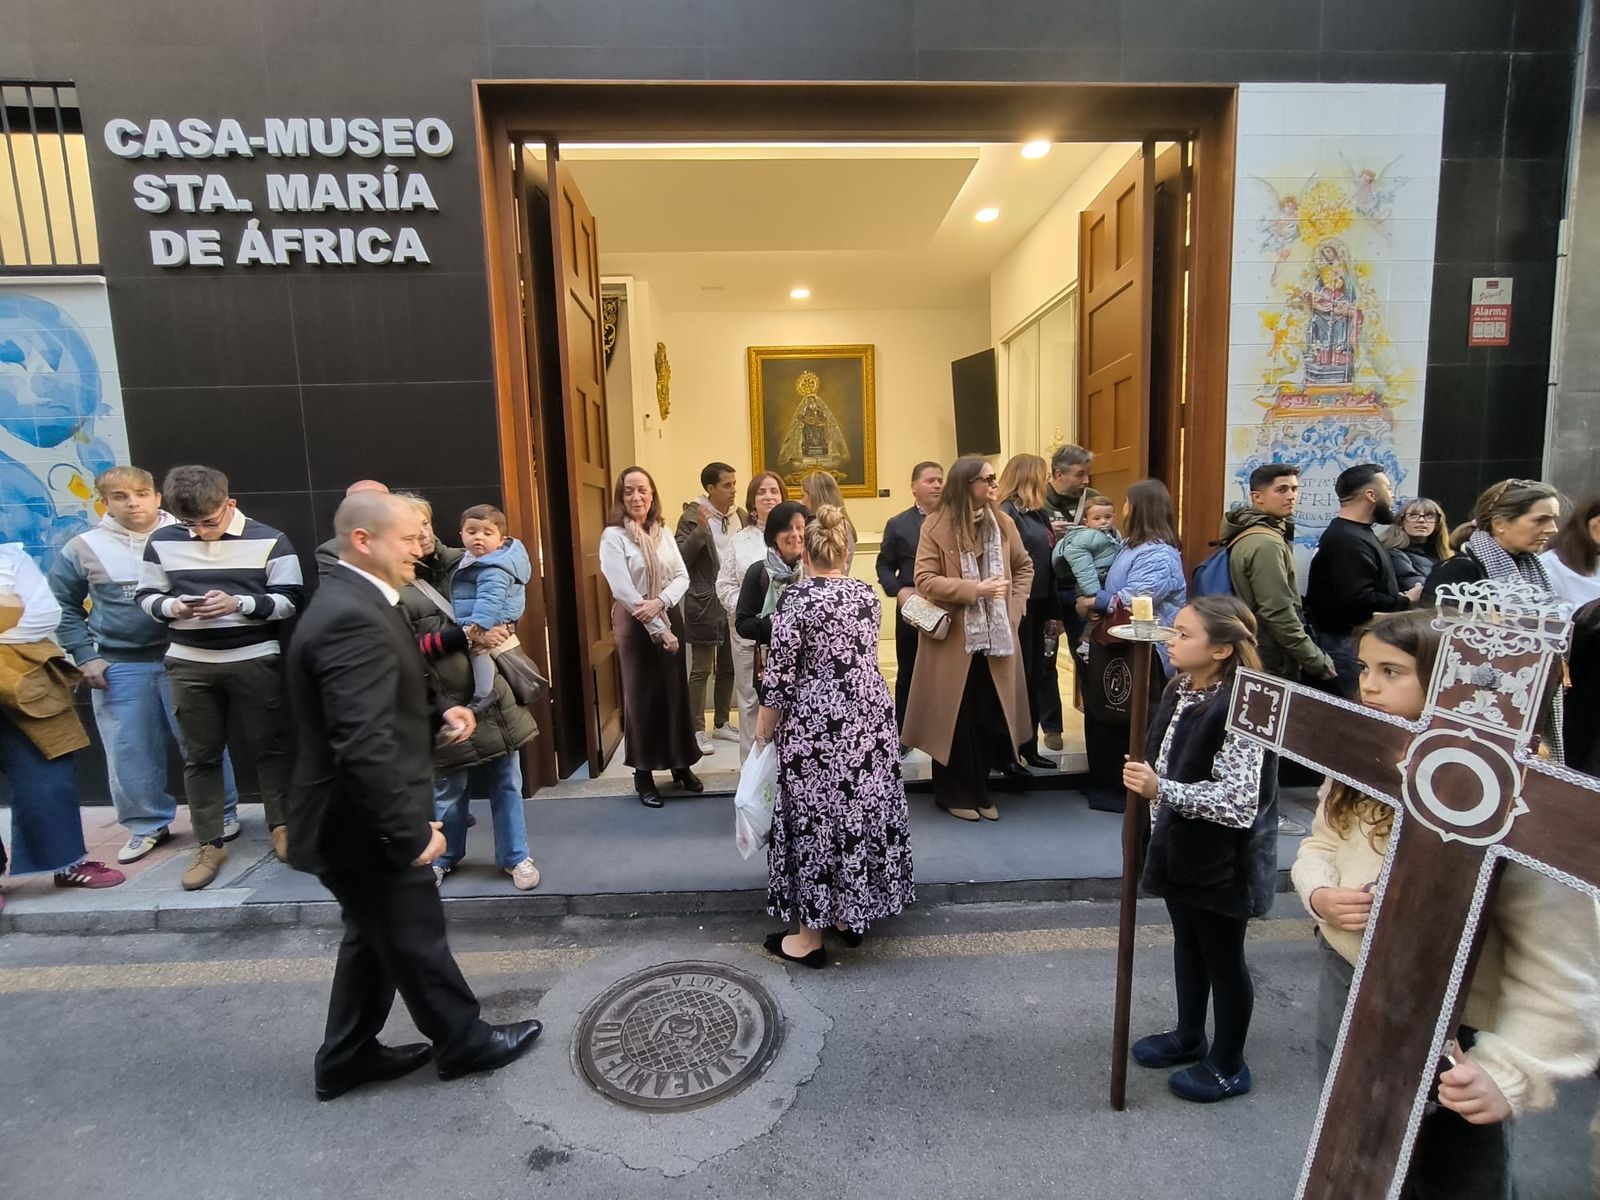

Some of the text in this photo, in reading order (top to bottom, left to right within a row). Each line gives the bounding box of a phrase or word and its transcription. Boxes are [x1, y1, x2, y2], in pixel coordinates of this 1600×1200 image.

[104, 118, 454, 159] CASA-MUSEO
[133, 164, 439, 214] STA. MARÍA
[150, 218, 431, 267] DE ÁFRICA
[1473, 306, 1508, 316] Alarma
[1298, 492, 1332, 507] FRI
[671, 976, 742, 999] CEUTA
[592, 1021, 748, 1098] SANEAMIENTO
